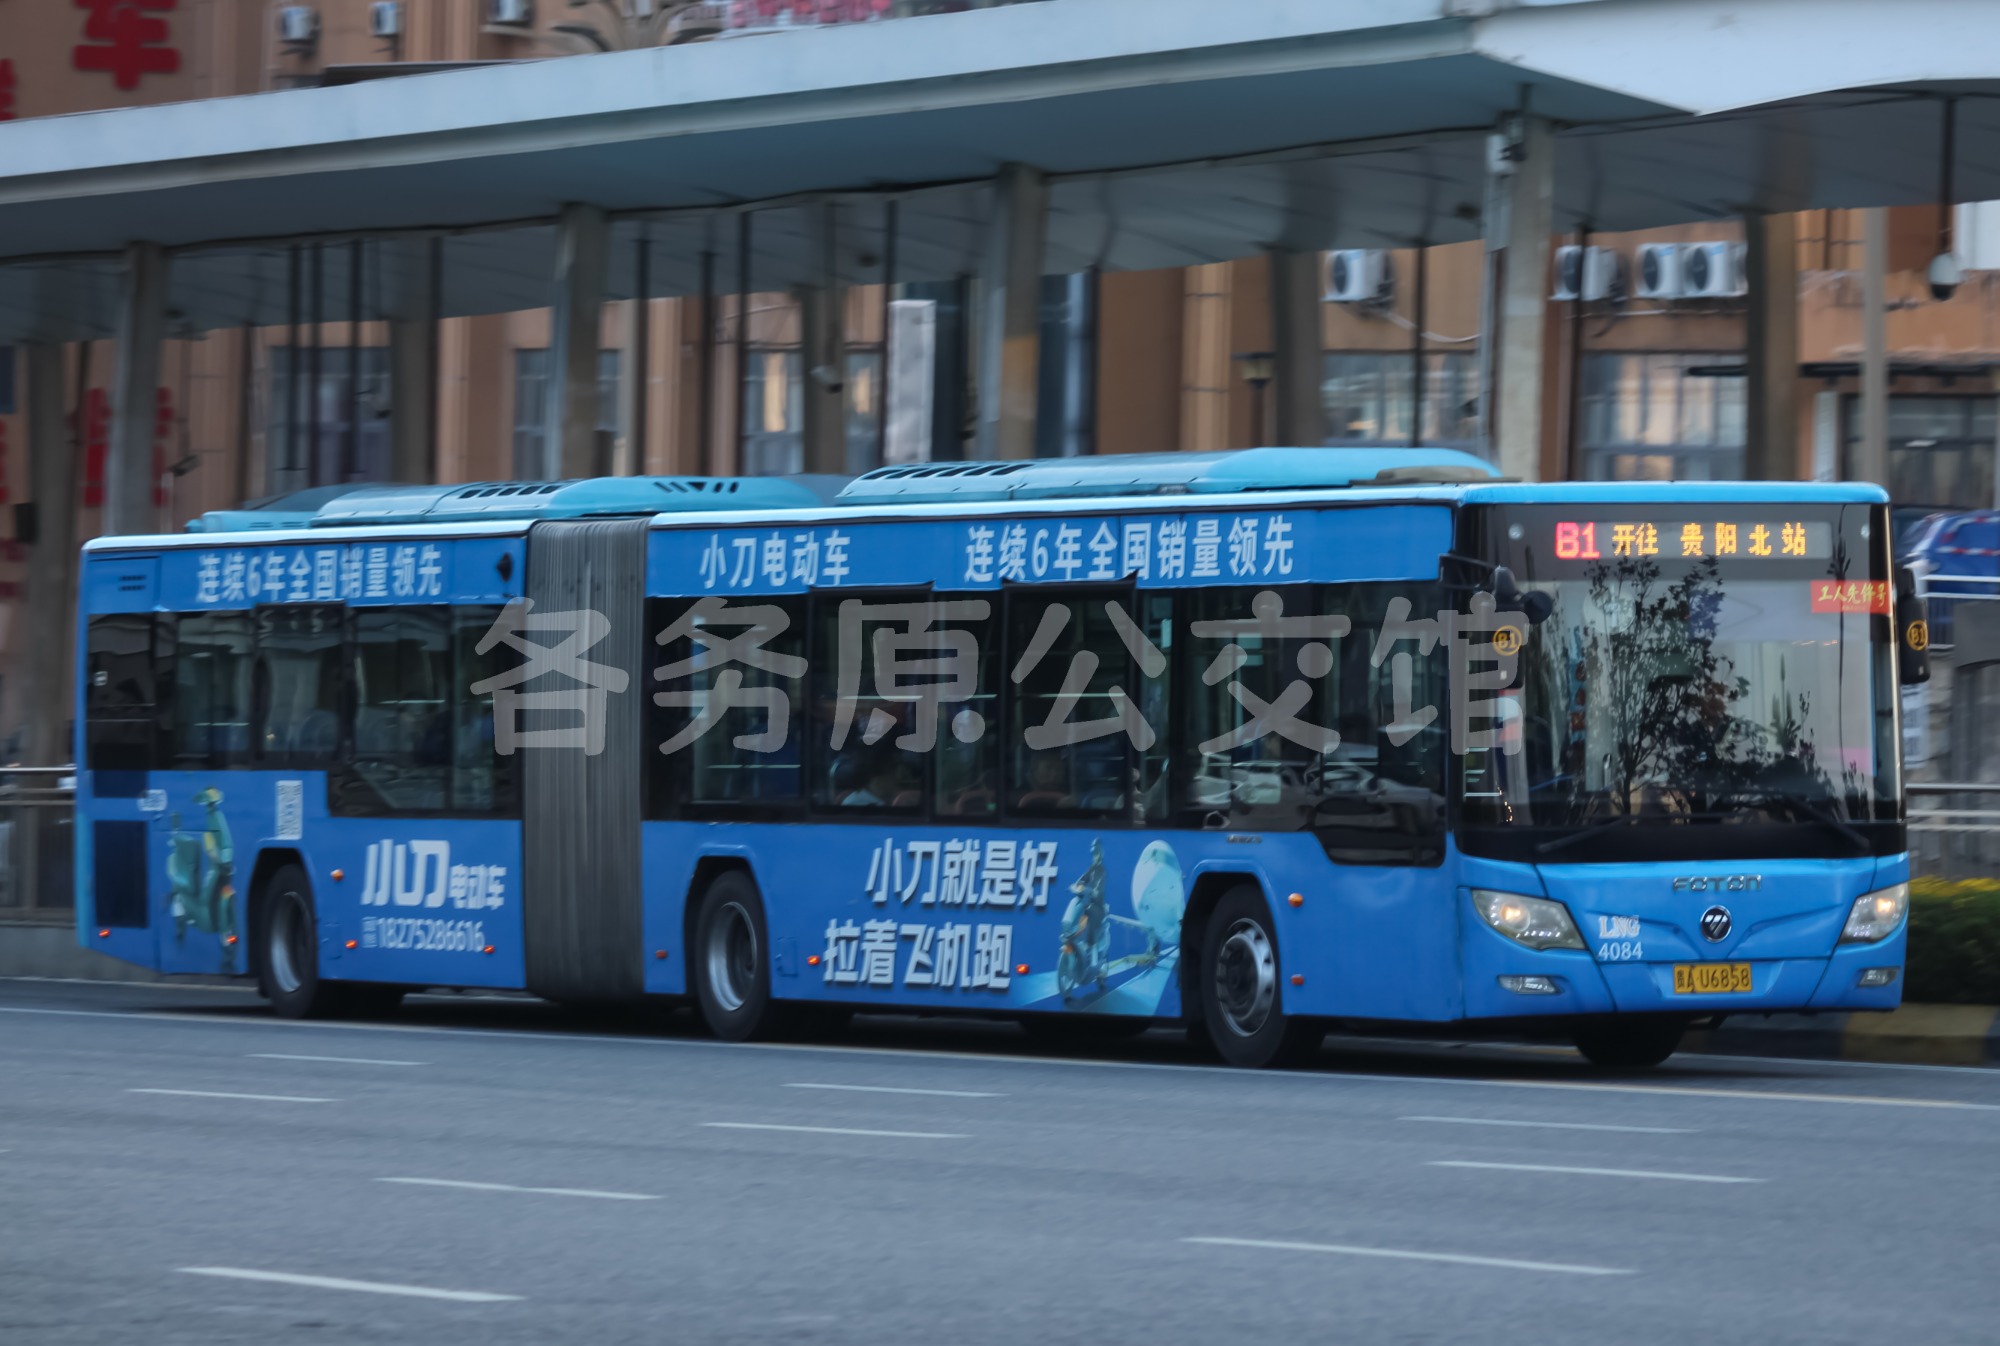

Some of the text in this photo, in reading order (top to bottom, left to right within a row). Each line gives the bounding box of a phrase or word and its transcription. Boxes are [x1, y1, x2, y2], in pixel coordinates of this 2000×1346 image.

[700, 530, 852, 588] 小刀电动车
[964, 514, 1295, 584] 连续6年全国销量领先
[1556, 521, 1806, 559] B1 开往 贵阳北站
[196, 544, 443, 603] 连续6年全国销量领先
[360, 838, 507, 909] 小刀电动车
[864, 838, 1058, 907] 小刀就是好
[1672, 874, 1762, 892] FOTON
[377, 917, 485, 952] 18275286616
[823, 918, 1013, 989] 拉着飞机跑
[1598, 915, 1640, 939] LNG
[1598, 941, 1643, 961] 4084
